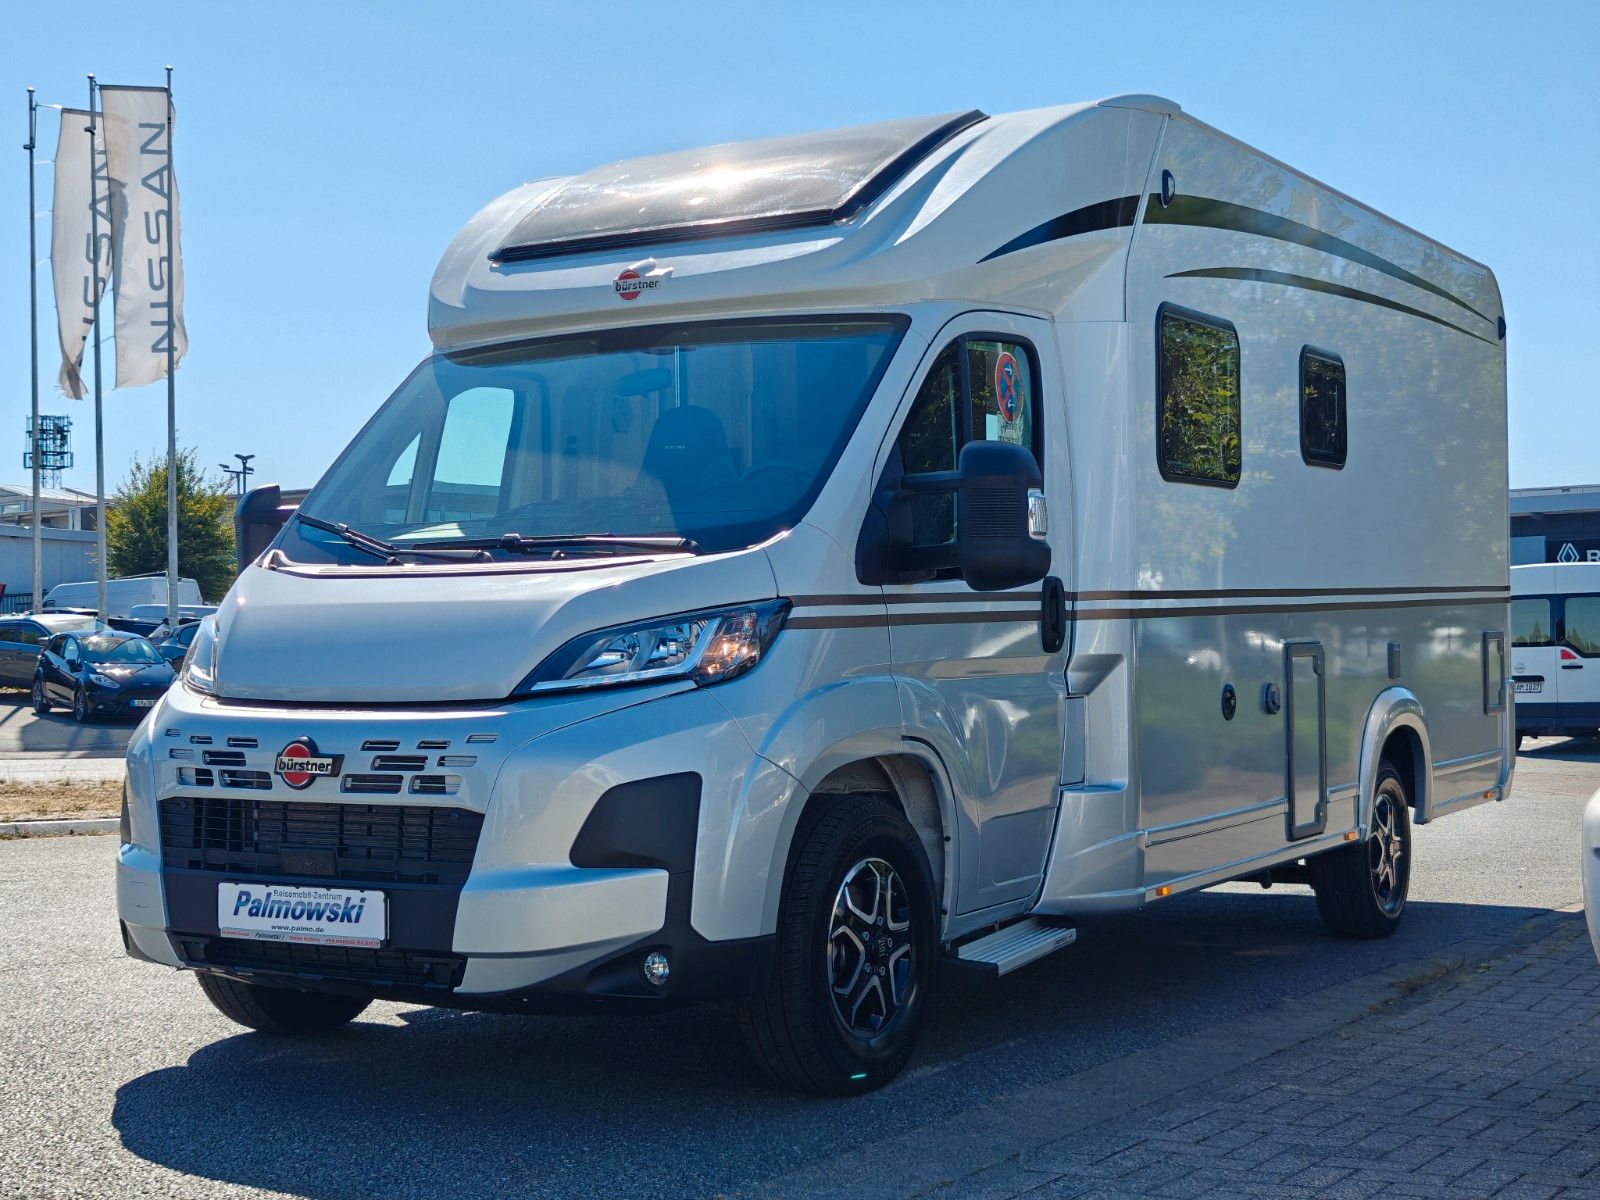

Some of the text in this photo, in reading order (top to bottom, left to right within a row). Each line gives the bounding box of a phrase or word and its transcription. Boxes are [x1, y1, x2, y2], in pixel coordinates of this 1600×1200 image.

[139, 122, 178, 354] NISSAN
[615, 280, 660, 292] bürstner
[278, 757, 332, 772] bürstner
[273, 889, 343, 901] Reisemobil-Zentrum
[233, 890, 367, 924] Palmowski
[270, 924, 325, 933] www.palmo.de
